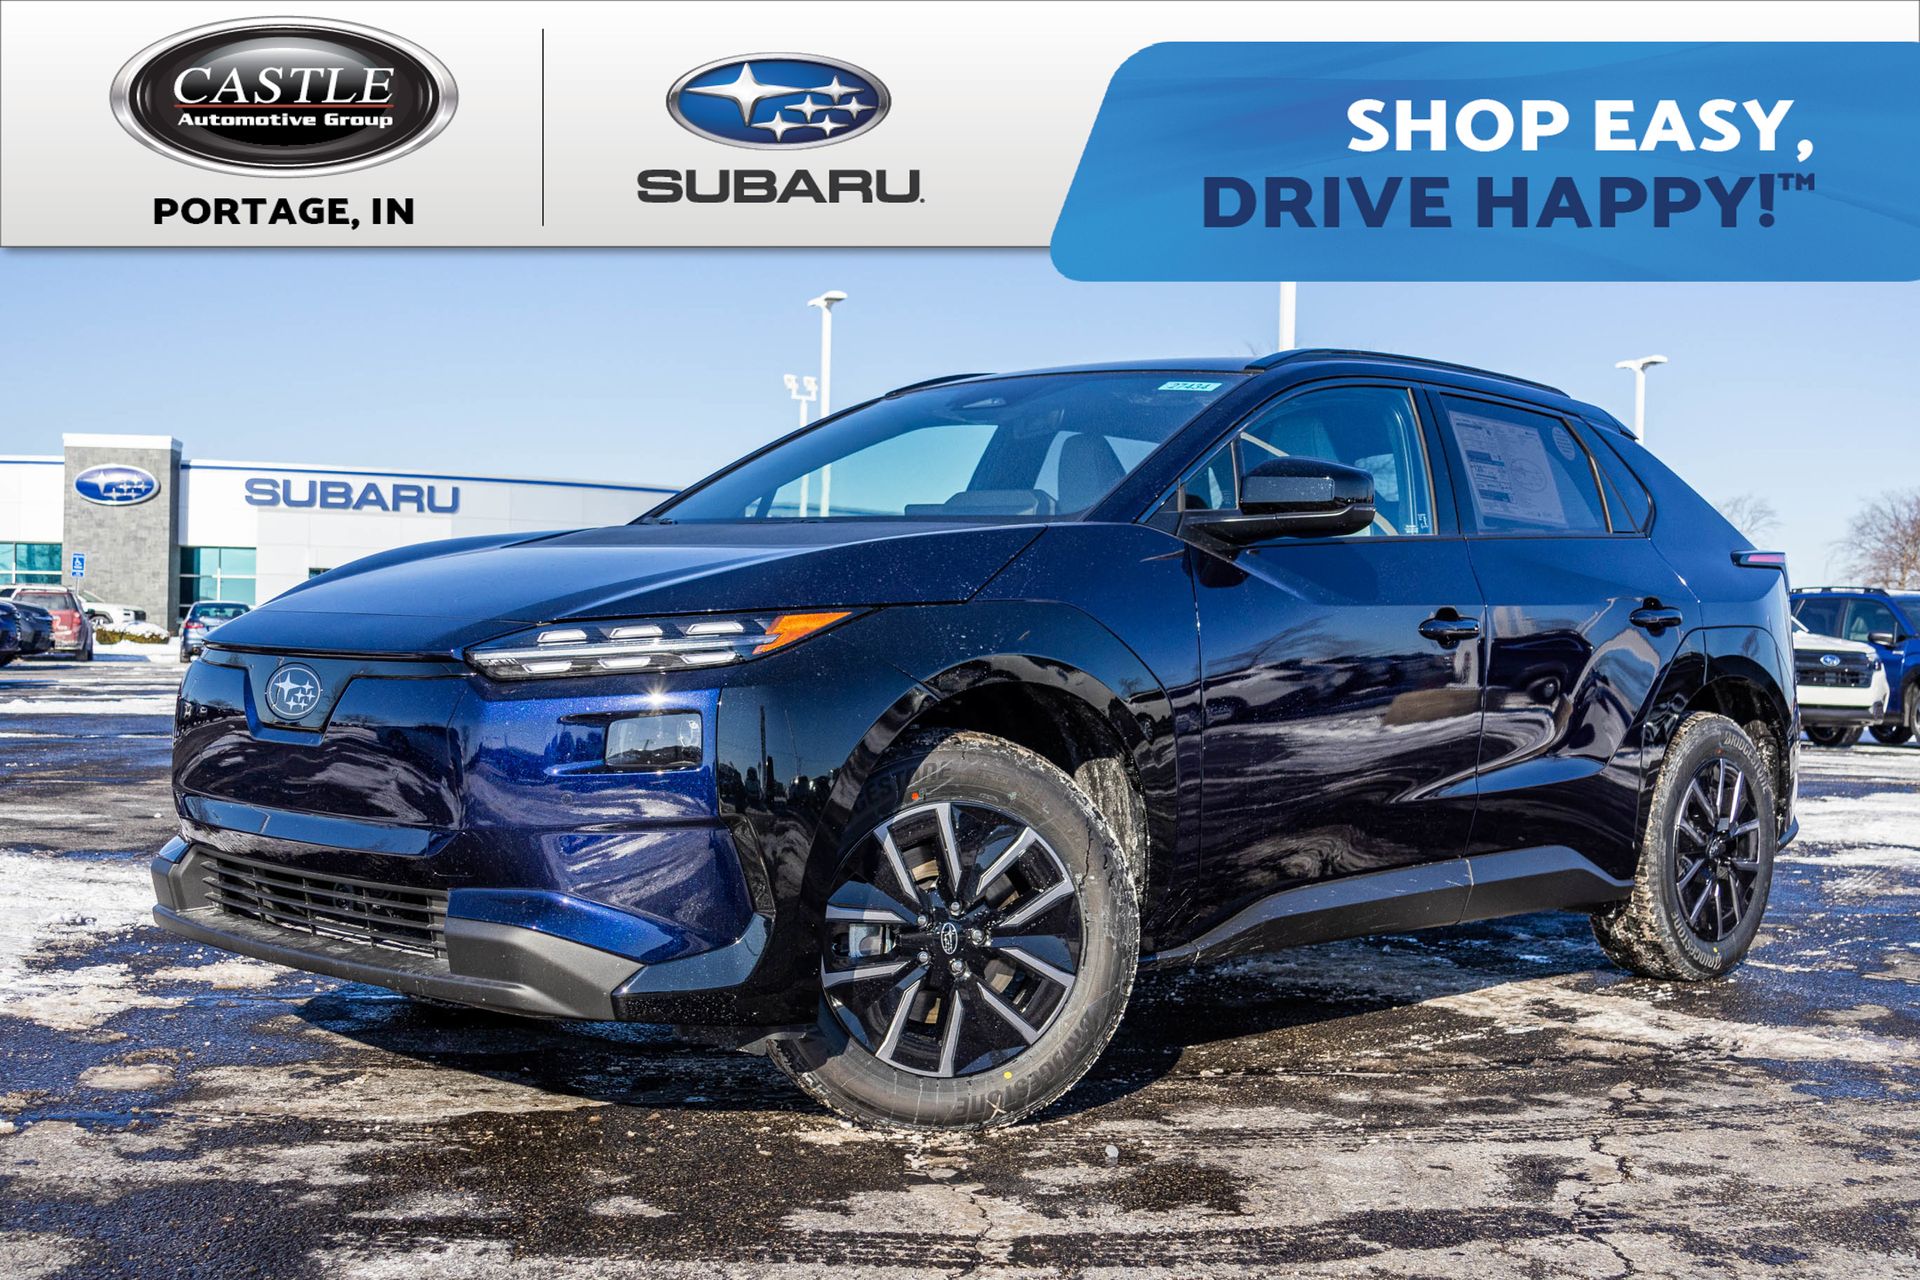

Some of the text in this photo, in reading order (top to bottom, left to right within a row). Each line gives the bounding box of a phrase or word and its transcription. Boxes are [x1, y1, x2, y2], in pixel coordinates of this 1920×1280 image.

[245, 477, 460, 514] SUBARU
[1724, 731, 1770, 794] BRIDGESTONE
[1671, 911, 1722, 970] BRIDGESTONE
